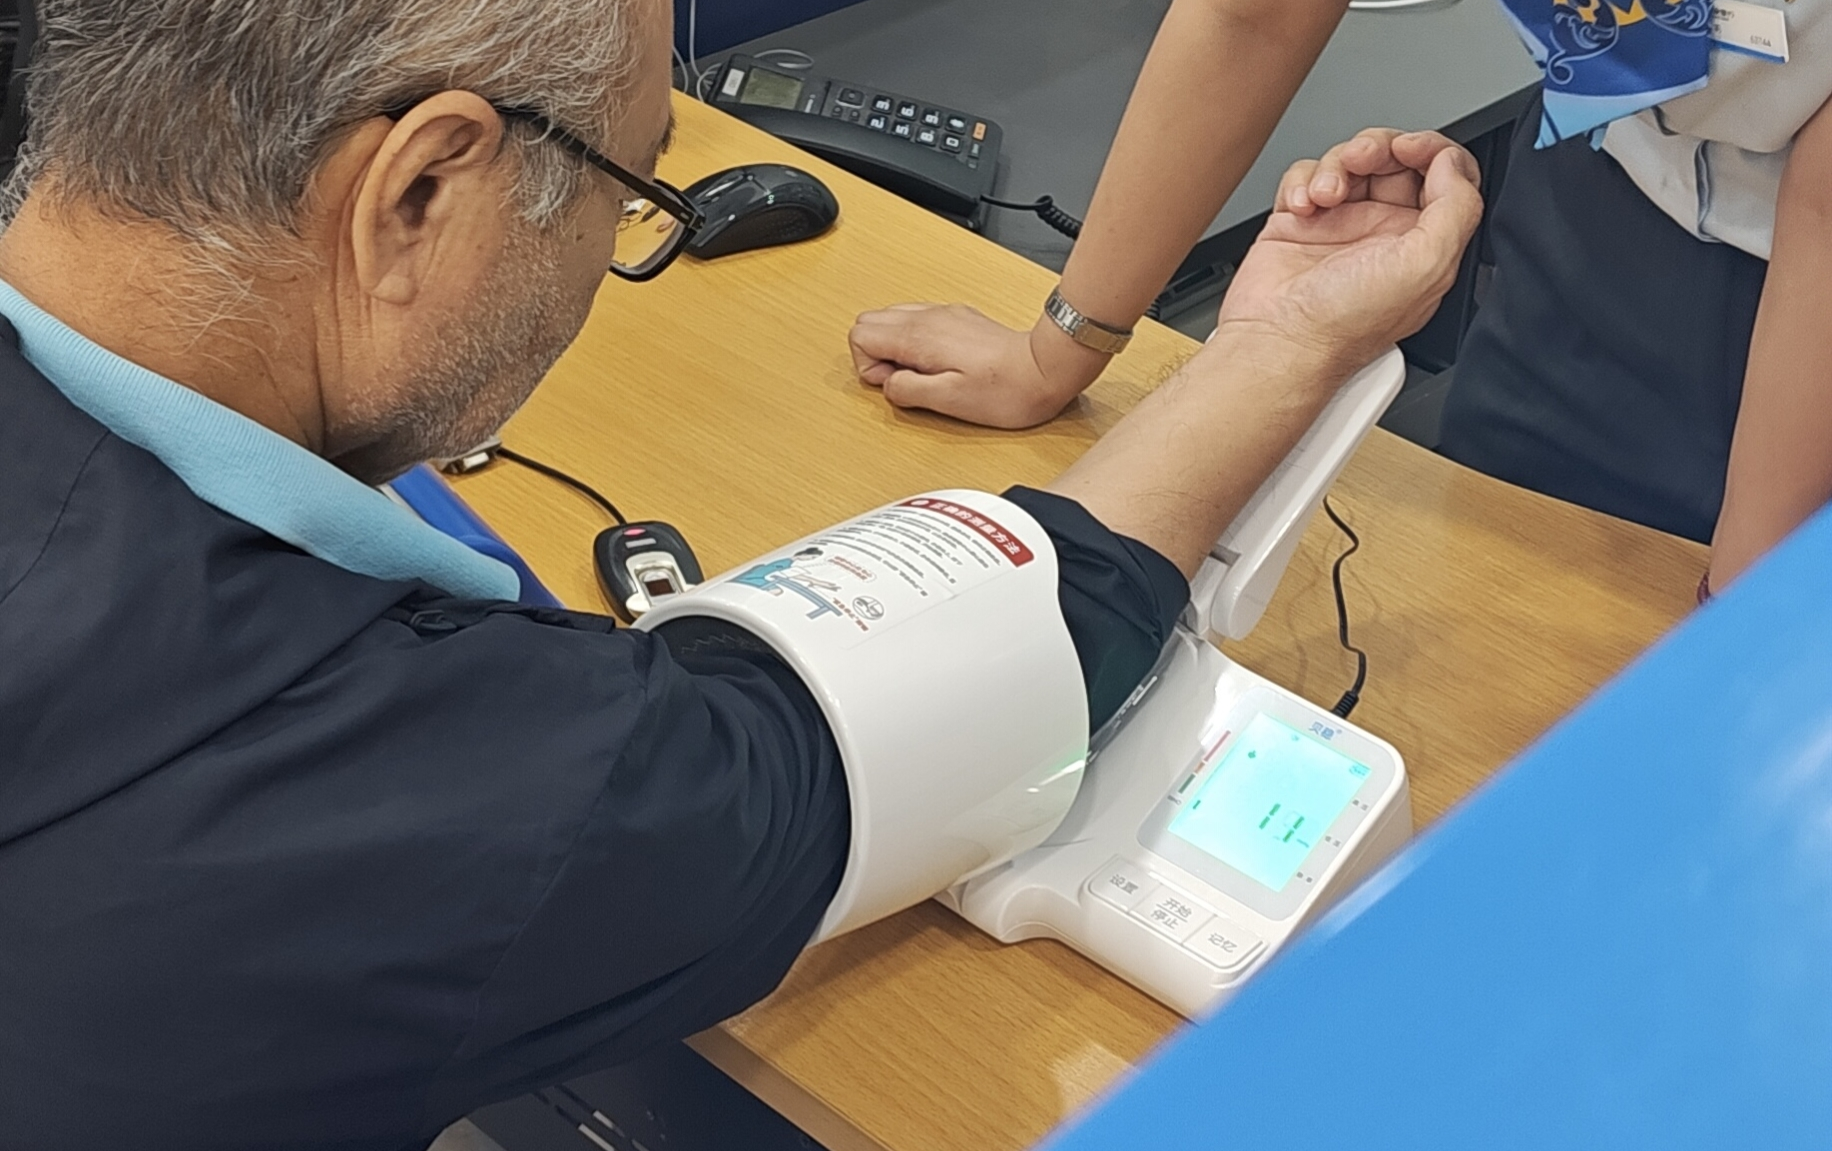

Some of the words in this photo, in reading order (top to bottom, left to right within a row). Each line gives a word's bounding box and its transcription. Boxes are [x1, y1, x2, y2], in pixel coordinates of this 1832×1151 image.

[875, 99, 890, 111] 3
[900, 106, 914, 118] 6
[929, 501, 1021, 556] 正确的测量方法
[1109, 874, 1139, 895] 设置
[1161, 897, 1192, 918] 开始
[1150, 909, 1179, 930] 停止
[1207, 932, 1238, 954] 记忆
